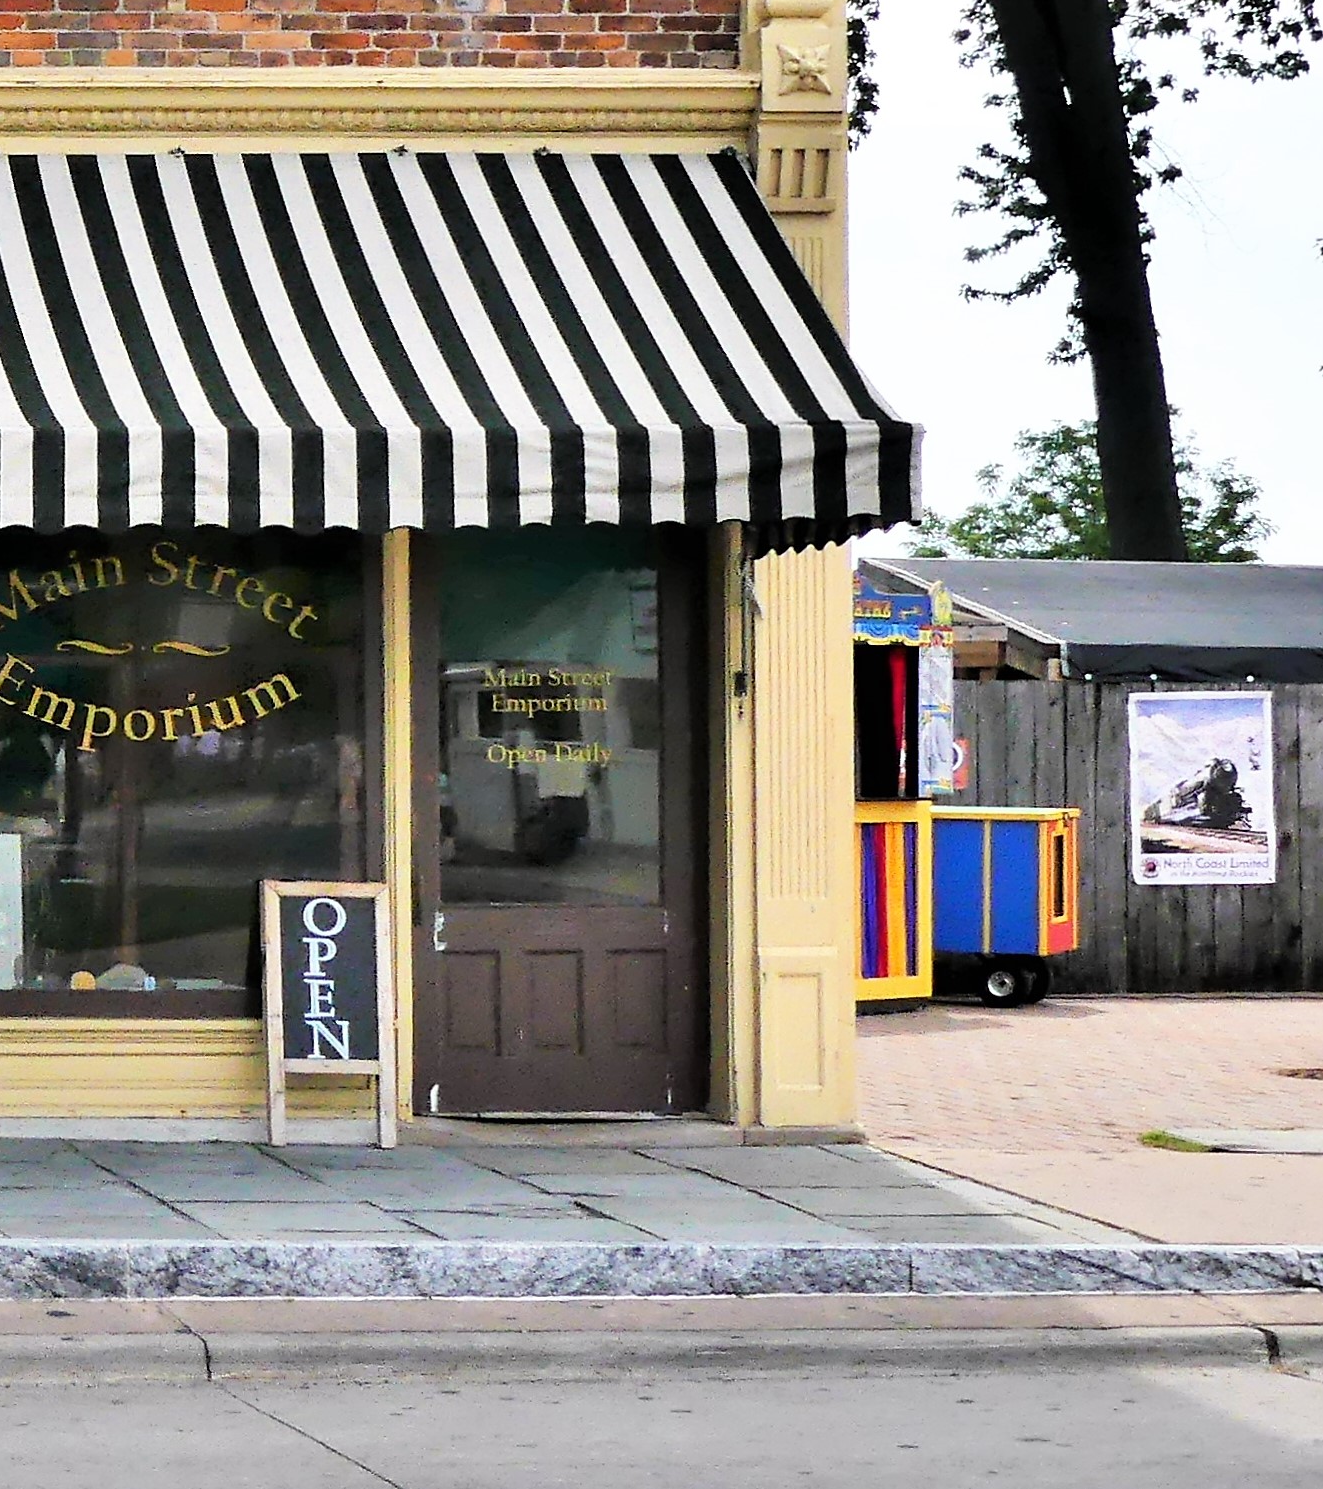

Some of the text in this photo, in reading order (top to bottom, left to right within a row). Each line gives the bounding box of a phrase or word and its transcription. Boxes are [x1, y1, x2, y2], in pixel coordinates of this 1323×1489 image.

[148, 541, 319, 640] Street
[484, 667, 611, 687] Main Street
[491, 693, 608, 719] Emporium
[487, 741, 612, 769] Open Daily
[1163, 856, 1193, 869] North
[1196, 857, 1226, 869] Coast
[1230, 856, 1269, 869] Limited
[302, 897, 352, 1061] OPEN
